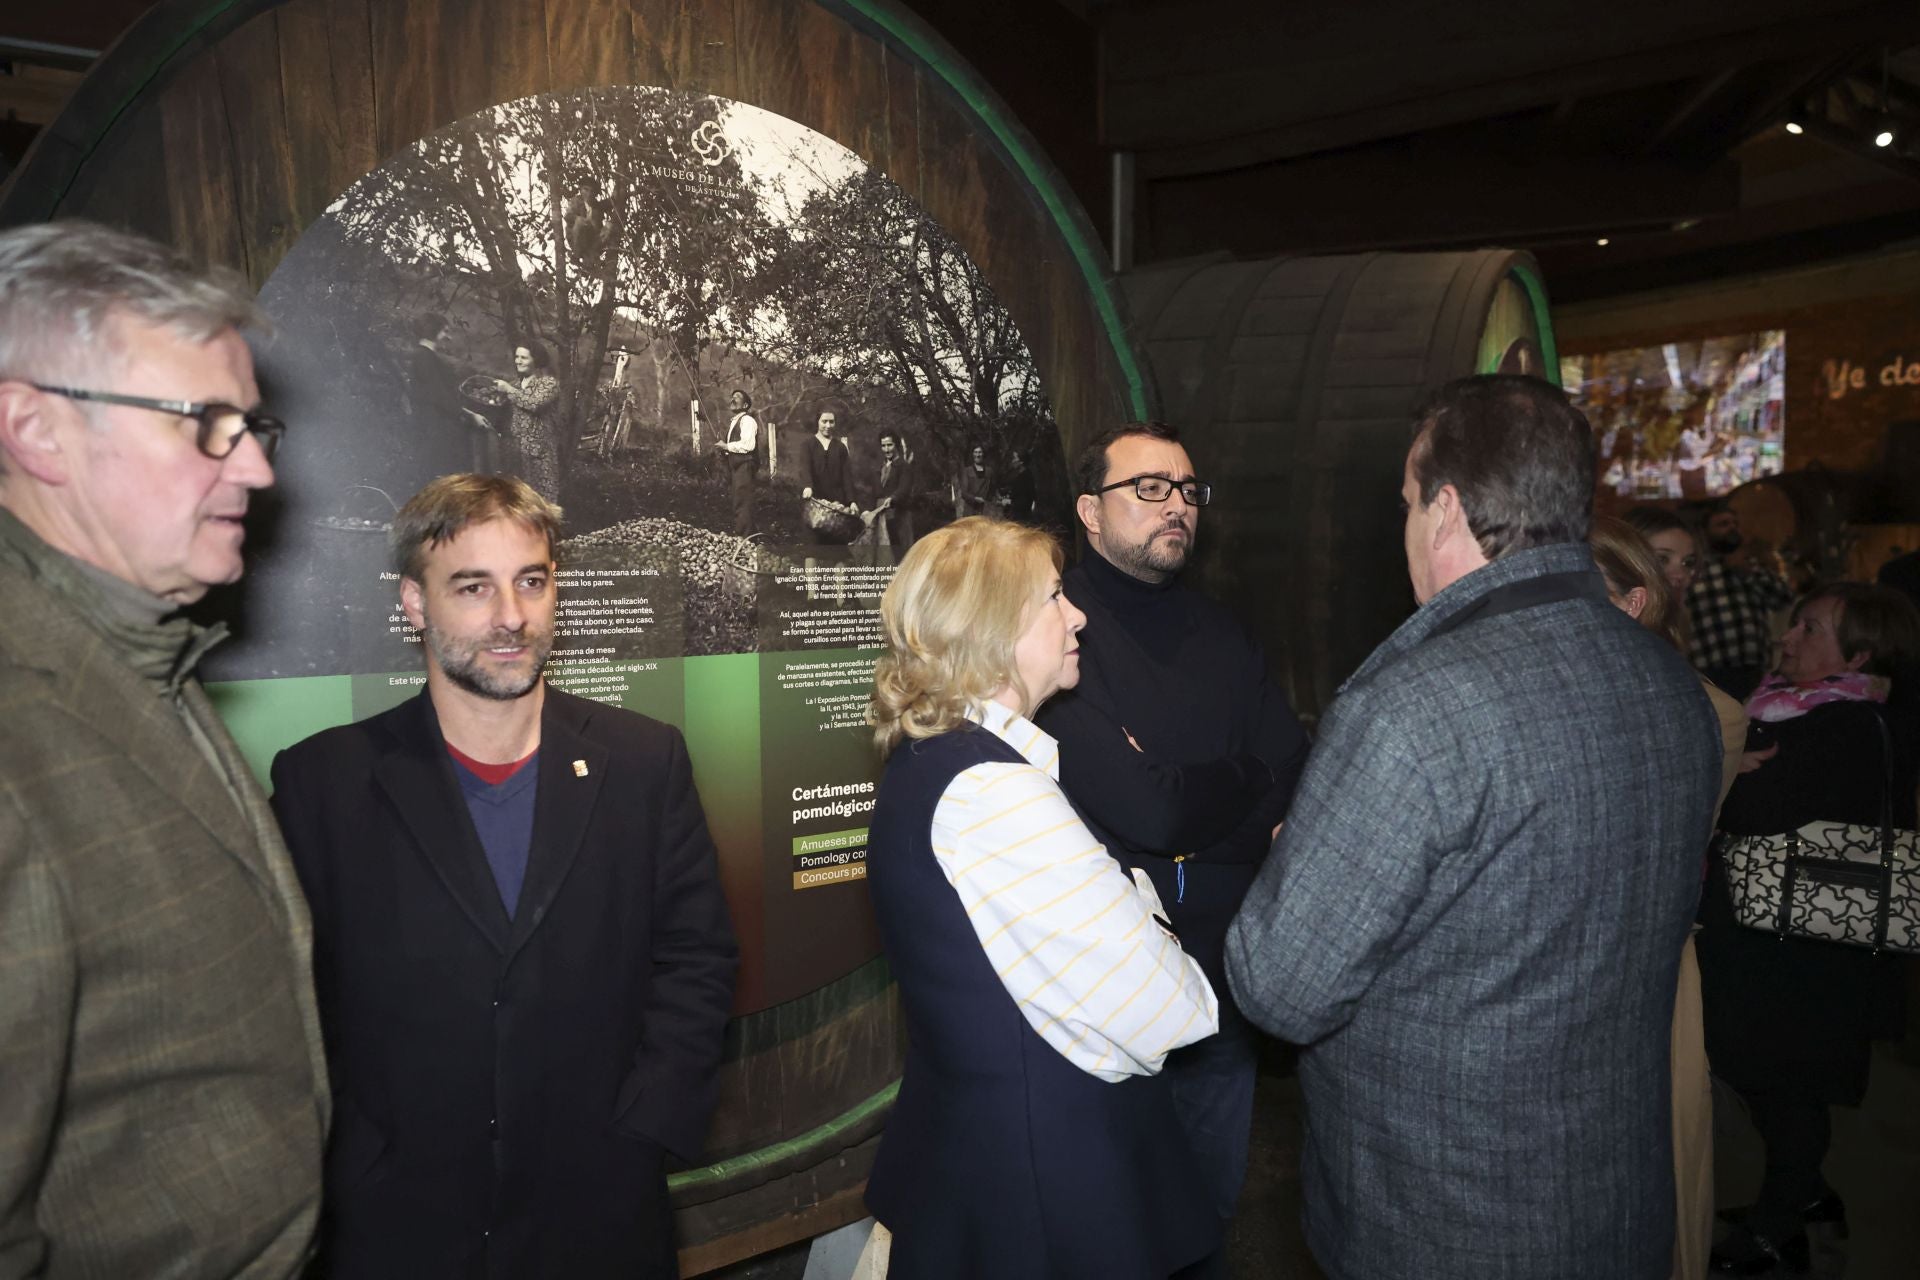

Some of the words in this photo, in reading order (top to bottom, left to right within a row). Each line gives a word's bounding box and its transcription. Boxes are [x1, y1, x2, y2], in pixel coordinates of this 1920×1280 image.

[652, 166, 694, 181] MUSEO
[699, 174, 713, 184] DE
[718, 177, 731, 187] LA
[553, 569, 584, 577] cosecha
[841, 565, 874, 574] promovidos
[380, 572, 400, 580] Alter
[775, 575, 797, 584] Ignacio
[593, 580, 614, 588] pares.
[560, 598, 601, 608] plantación,
[611, 597, 648, 605] realización
[566, 608, 613, 616] fitosanitarios
[792, 610, 809, 619] aquel
[831, 609, 856, 617] pusieron
[389, 614, 399, 622] de
[568, 618, 582, 626] más
[562, 628, 571, 636] de
[581, 627, 598, 635] fruta
[600, 626, 644, 634] recolectada.
[816, 627, 840, 635] personal
[550, 648, 584, 656] manzana
[586, 647, 594, 655] de
[578, 656, 611, 665] acusada.
[786, 662, 829, 671] Paralelamente,
[839, 660, 864, 668] procedió
[562, 667, 585, 675] última
[587, 665, 613, 674] década
[615, 664, 626, 672] del
[628, 664, 644, 673] siglo
[778, 673, 785, 681] de
[815, 670, 846, 678] existentes,
[848, 668, 876, 676] efectuand
[389, 677, 407, 685] Este
[410, 675, 426, 685] tipo
[566, 677, 589, 687] países
[591, 675, 624, 685] europeos
[821, 679, 852, 687] diagramas,
[818, 694, 849, 704] Exposición
[792, 781, 874, 801] Certámenes
[792, 799, 877, 824] pomológicos
[801, 835, 846, 851] Amueses
[801, 851, 851, 868] Pomology
[801, 869, 849, 884] Concours
